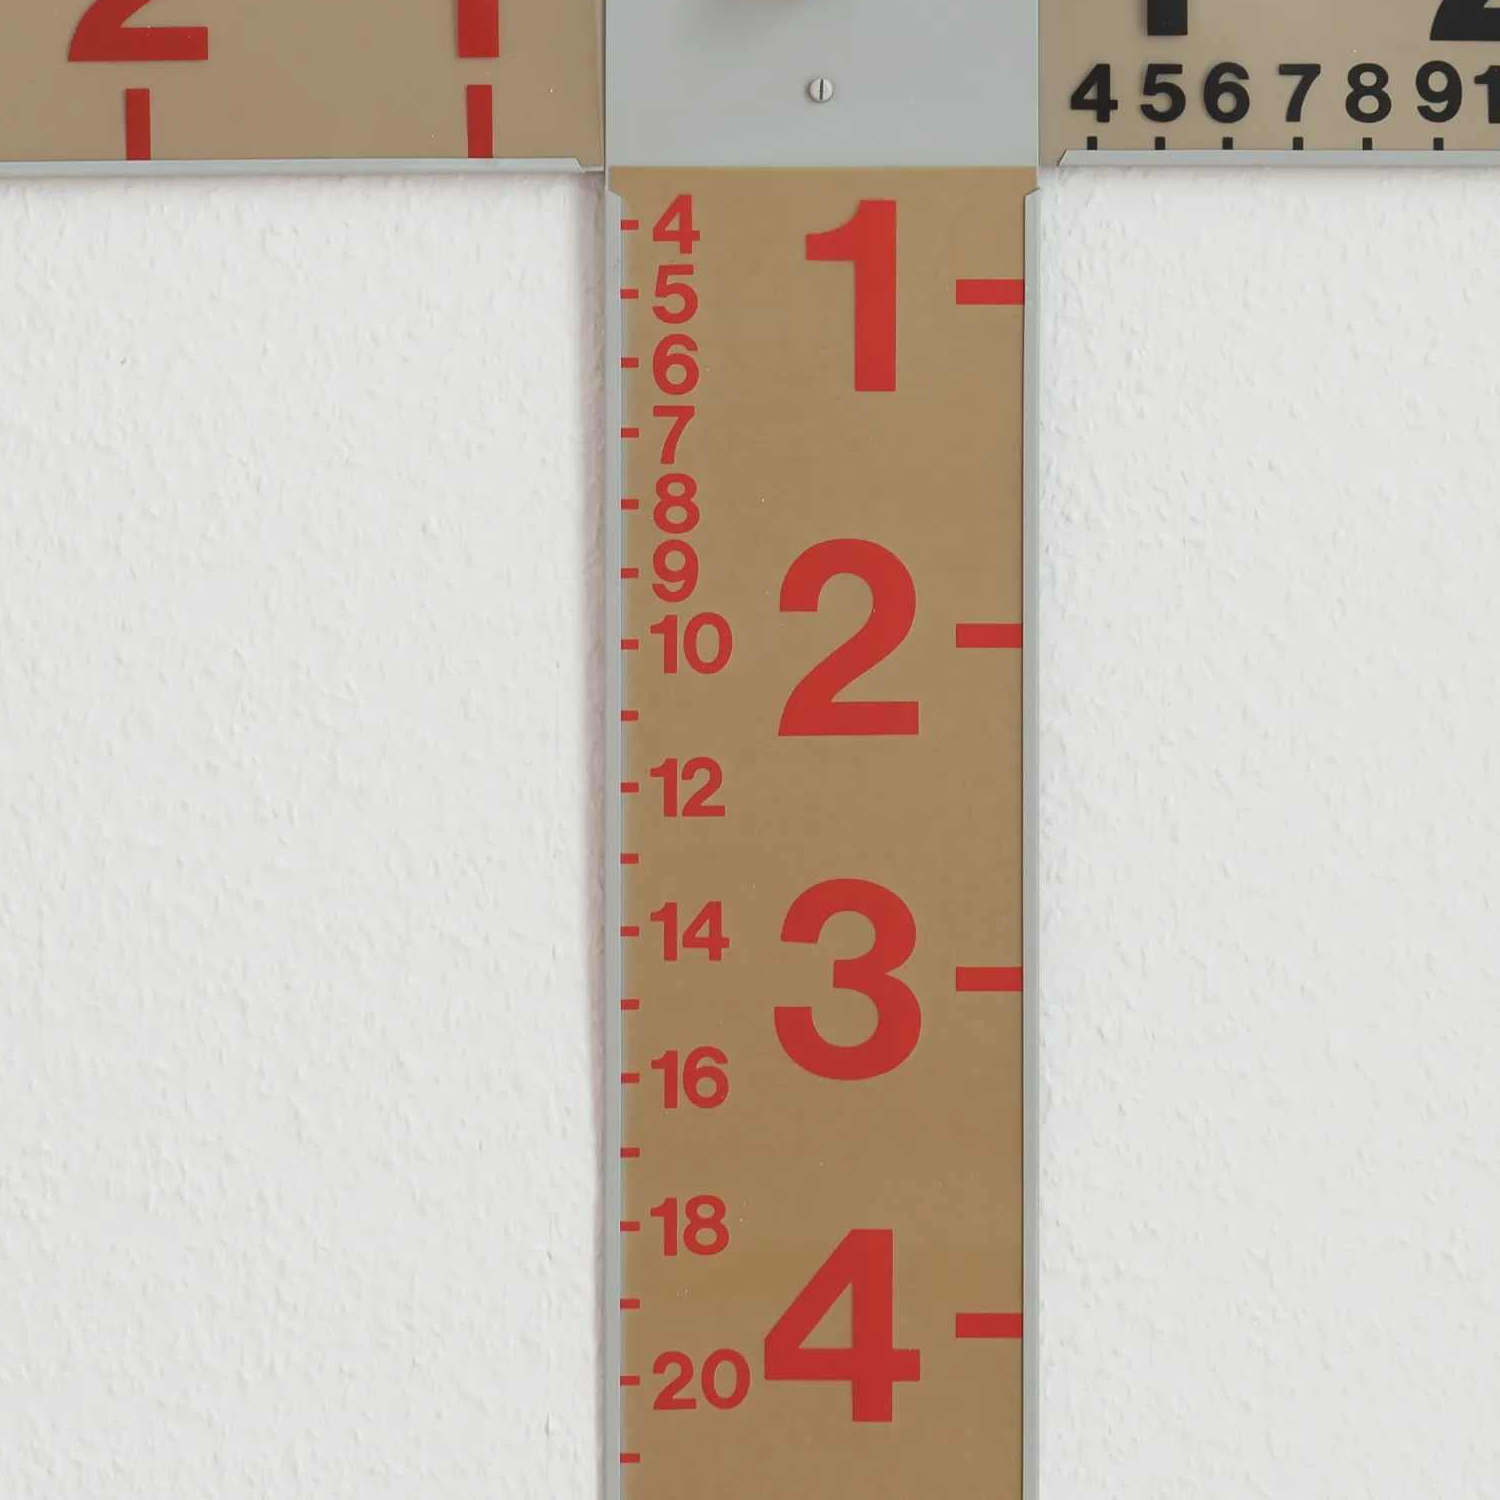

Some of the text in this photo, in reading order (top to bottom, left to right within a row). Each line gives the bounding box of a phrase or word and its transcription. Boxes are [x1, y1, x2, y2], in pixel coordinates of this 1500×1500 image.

[1070, 63, 1119, 124] 4
[1139, 63, 1187, 123] 5
[1202, 61, 1250, 124] 6
[1278, 63, 1321, 123] 7
[1345, 62, 1392, 124] 8
[1415, 60, 1463, 123] 9
[652, 193, 701, 255] 4
[652, 263, 699, 325] 5
[805, 198, 898, 393] 1
[652, 332, 700, 396] 6
[651, 404, 696, 465] 7
[653, 472, 700, 535] 8
[652, 538, 700, 603] 9
[649, 612, 734, 675] 10
[777, 537, 920, 737] 2
[649, 756, 726, 818] 12
[649, 900, 731, 962] 14
[773, 877, 923, 1082] 3
[649, 1045, 730, 1109] 16
[649, 1194, 731, 1257] 18
[763, 1227, 921, 1423] 4
[652, 1347, 752, 1411] 20
